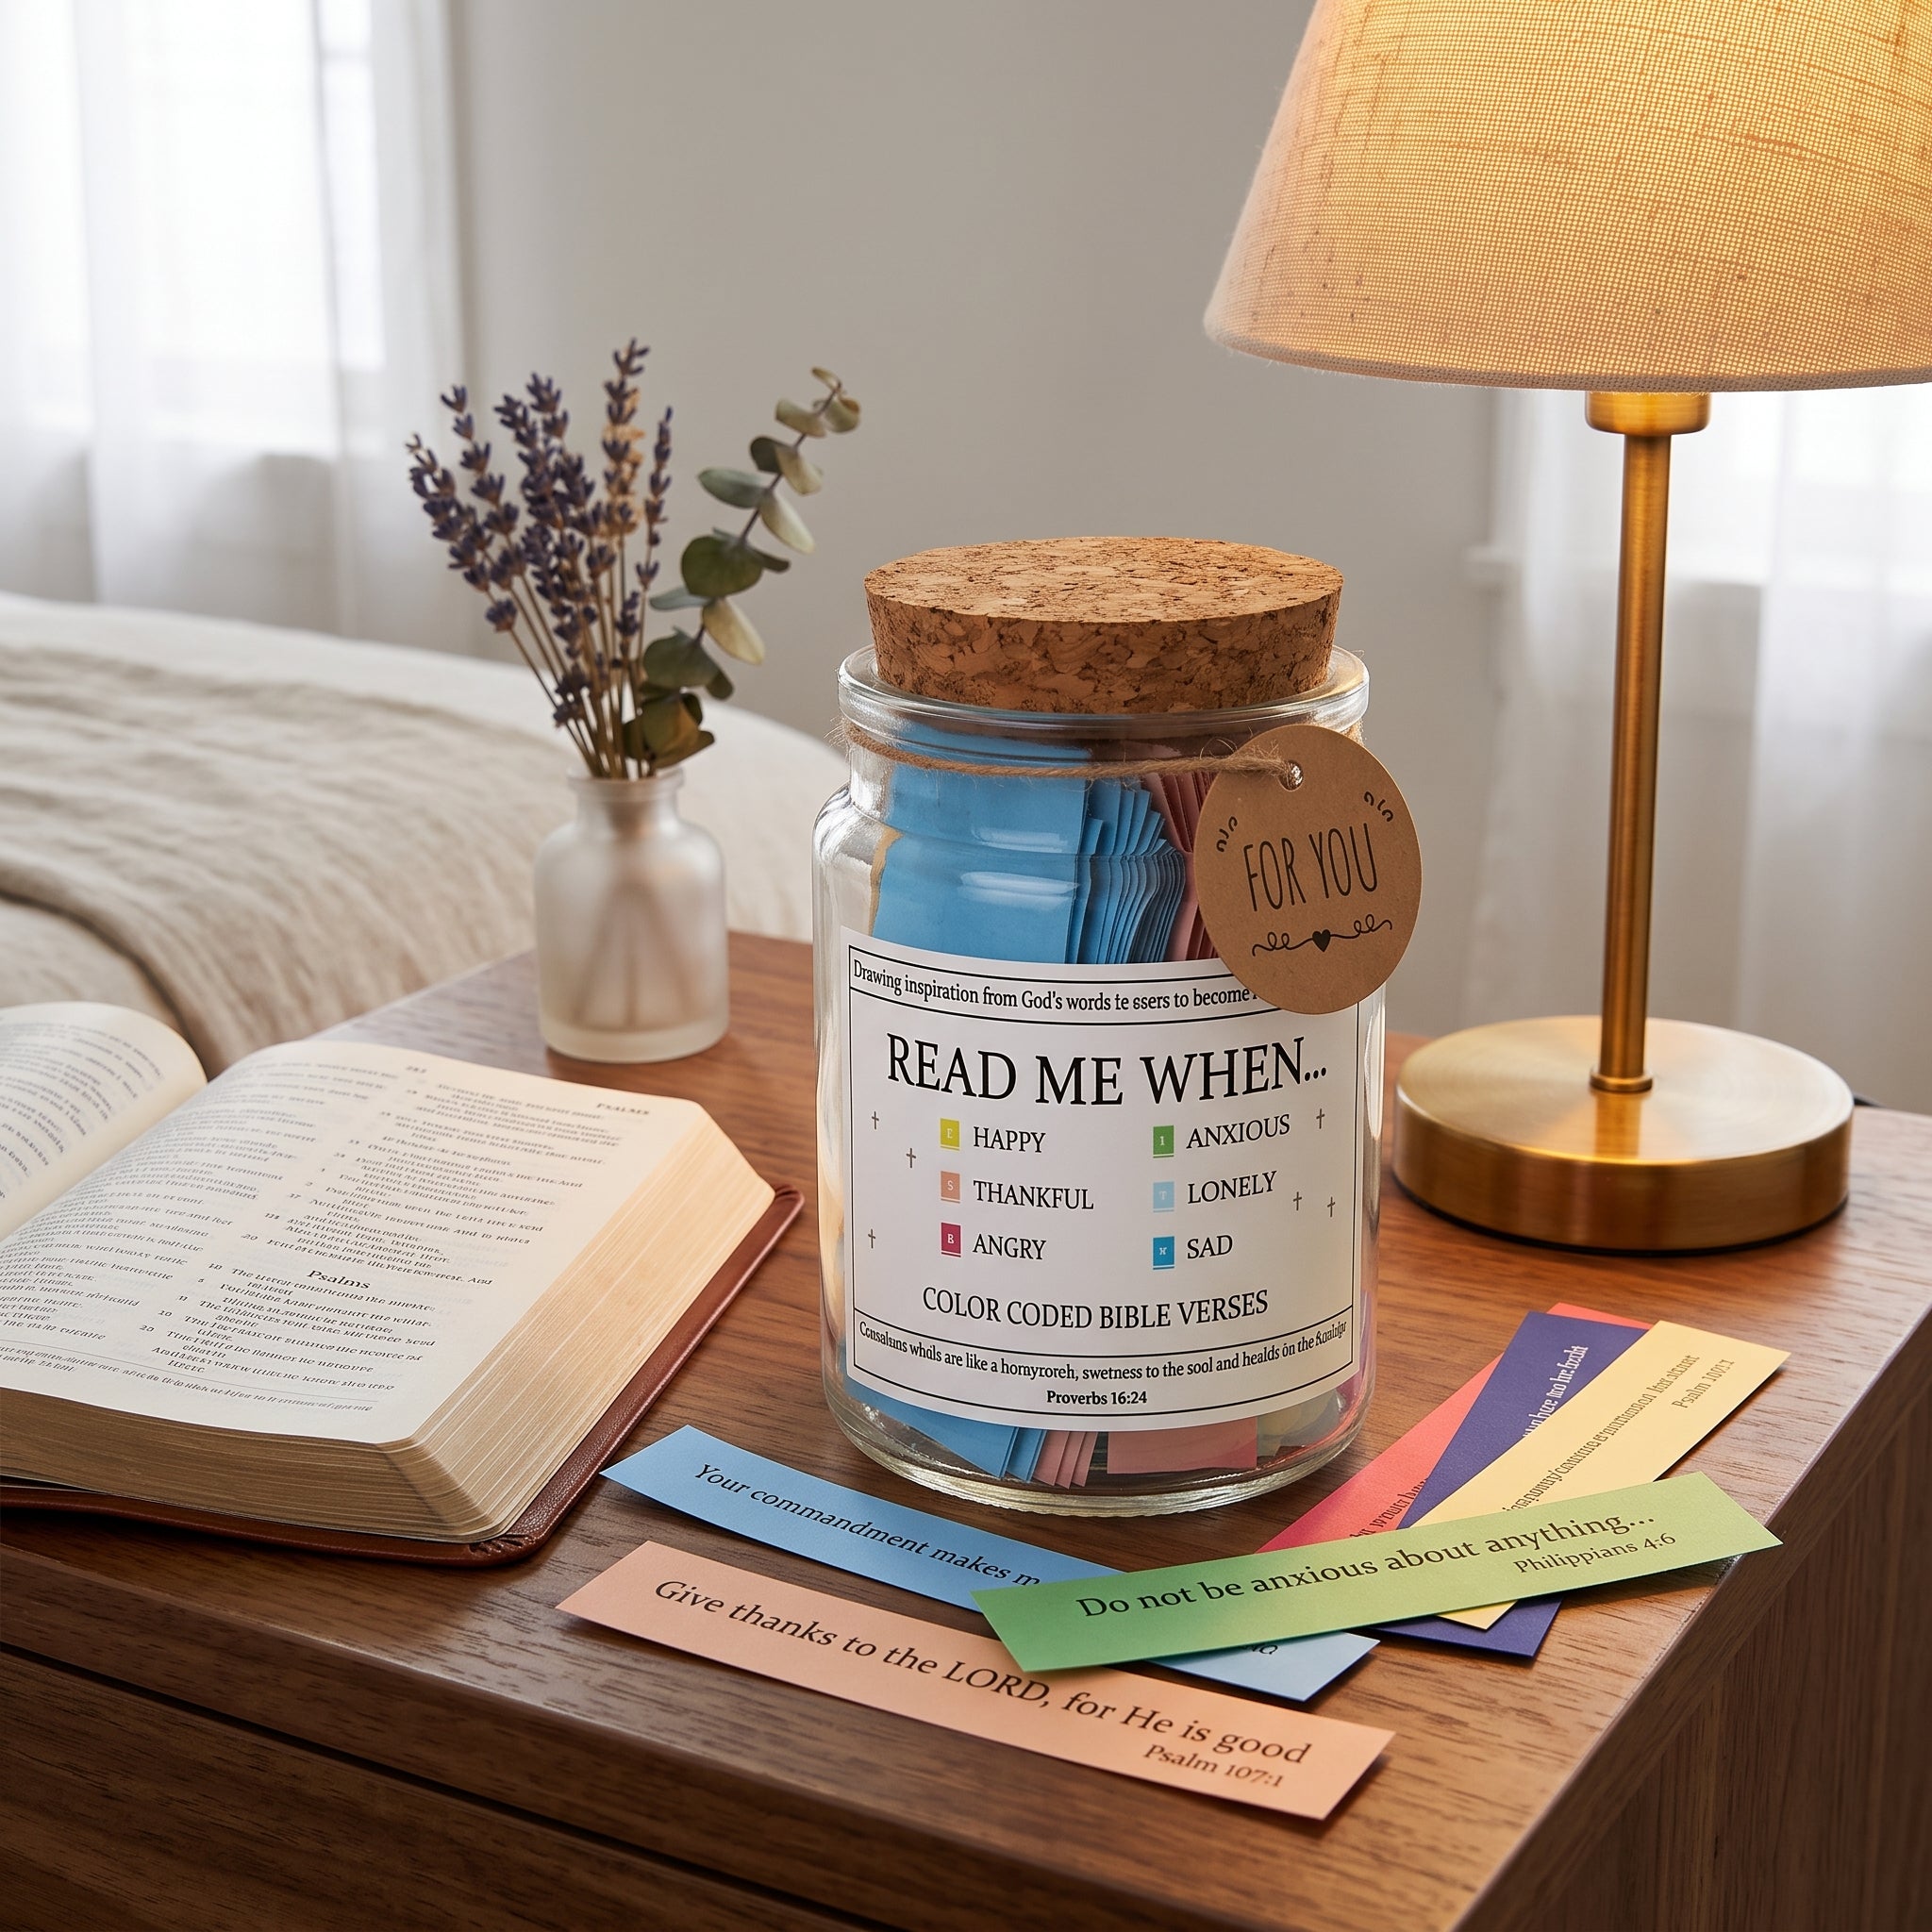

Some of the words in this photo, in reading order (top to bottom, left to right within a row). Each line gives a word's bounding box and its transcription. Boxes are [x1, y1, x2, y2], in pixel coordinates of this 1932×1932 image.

[1243, 837, 1307, 912] FOR
[1308, 823, 1378, 899] YOU
[854, 958, 903, 996] Drawing
[905, 974, 979, 1002] inspiration
[982, 986, 1018, 1008] from
[1022, 991, 1063, 1010] God's
[1066, 992, 1111, 1011] words
[1174, 992, 1190, 1008] to
[1192, 988, 1250, 1007] become
[887, 1032, 1017, 1100] READ
[1035, 1055, 1124, 1105] ME
[1140, 1036, 1327, 1105] WHEN...
[973, 1125, 1046, 1153] HAPPY
[1186, 1113, 1291, 1149] ANXIOUS
[973, 1180, 1094, 1210] THANKFUL
[1188, 1170, 1277, 1205] LONELY
[973, 1233, 1046, 1260] ANGRY
[1187, 1234, 1233, 1259] SAD
[307, 1270, 371, 1290] Psalms
[923, 1287, 1002, 1323] COLOR
[1007, 1301, 1092, 1328] CODED
[1099, 1304, 1171, 1328] BIBLE
[1177, 1290, 1268, 1325] VERSES
[944, 1353, 963, 1366] are
[966, 1353, 988, 1372] like
[991, 1361, 998, 1373] a
[1082, 1367, 1142, 1380] swetness
[1146, 1365, 1159, 1378] to
[1162, 1361, 1184, 1377] the
[1187, 1357, 1213, 1375] sool
[1216, 1353, 1240, 1372] and
[1242, 1345, 1280, 1367] healds
[1297, 1337, 1314, 1353] the
[1046, 1391, 1108, 1406] Proverbs
[1110, 1391, 1148, 1405] 16:24
[694, 1464, 752, 1494] Your
[751, 1490, 930, 1556] commandment
[929, 1548, 1011, 1580] makes
[1075, 1597, 1130, 1617] Do
[1137, 1587, 1197, 1609] not
[1197, 1581, 1245, 1601] be
[1253, 1559, 1379, 1593] anxious
[1387, 1541, 1482, 1572] about
[1484, 1514, 1655, 1554] anything...
[1512, 1542, 1639, 1574] Philippians
[1642, 1532, 1676, 1550] 4:6
[655, 1580, 725, 1614] Give
[727, 1604, 839, 1646] thanks
[841, 1637, 877, 1657] to
[882, 1647, 938, 1674] the
[942, 1660, 1051, 1708] LORD,
[1061, 1691, 1118, 1720] for
[1120, 1706, 1174, 1734] He
[1179, 1720, 1212, 1743] is
[1213, 1733, 1313, 1764] good
[1143, 1744, 1218, 1774] Psalm
[1224, 1762, 1285, 1788] 107:1
